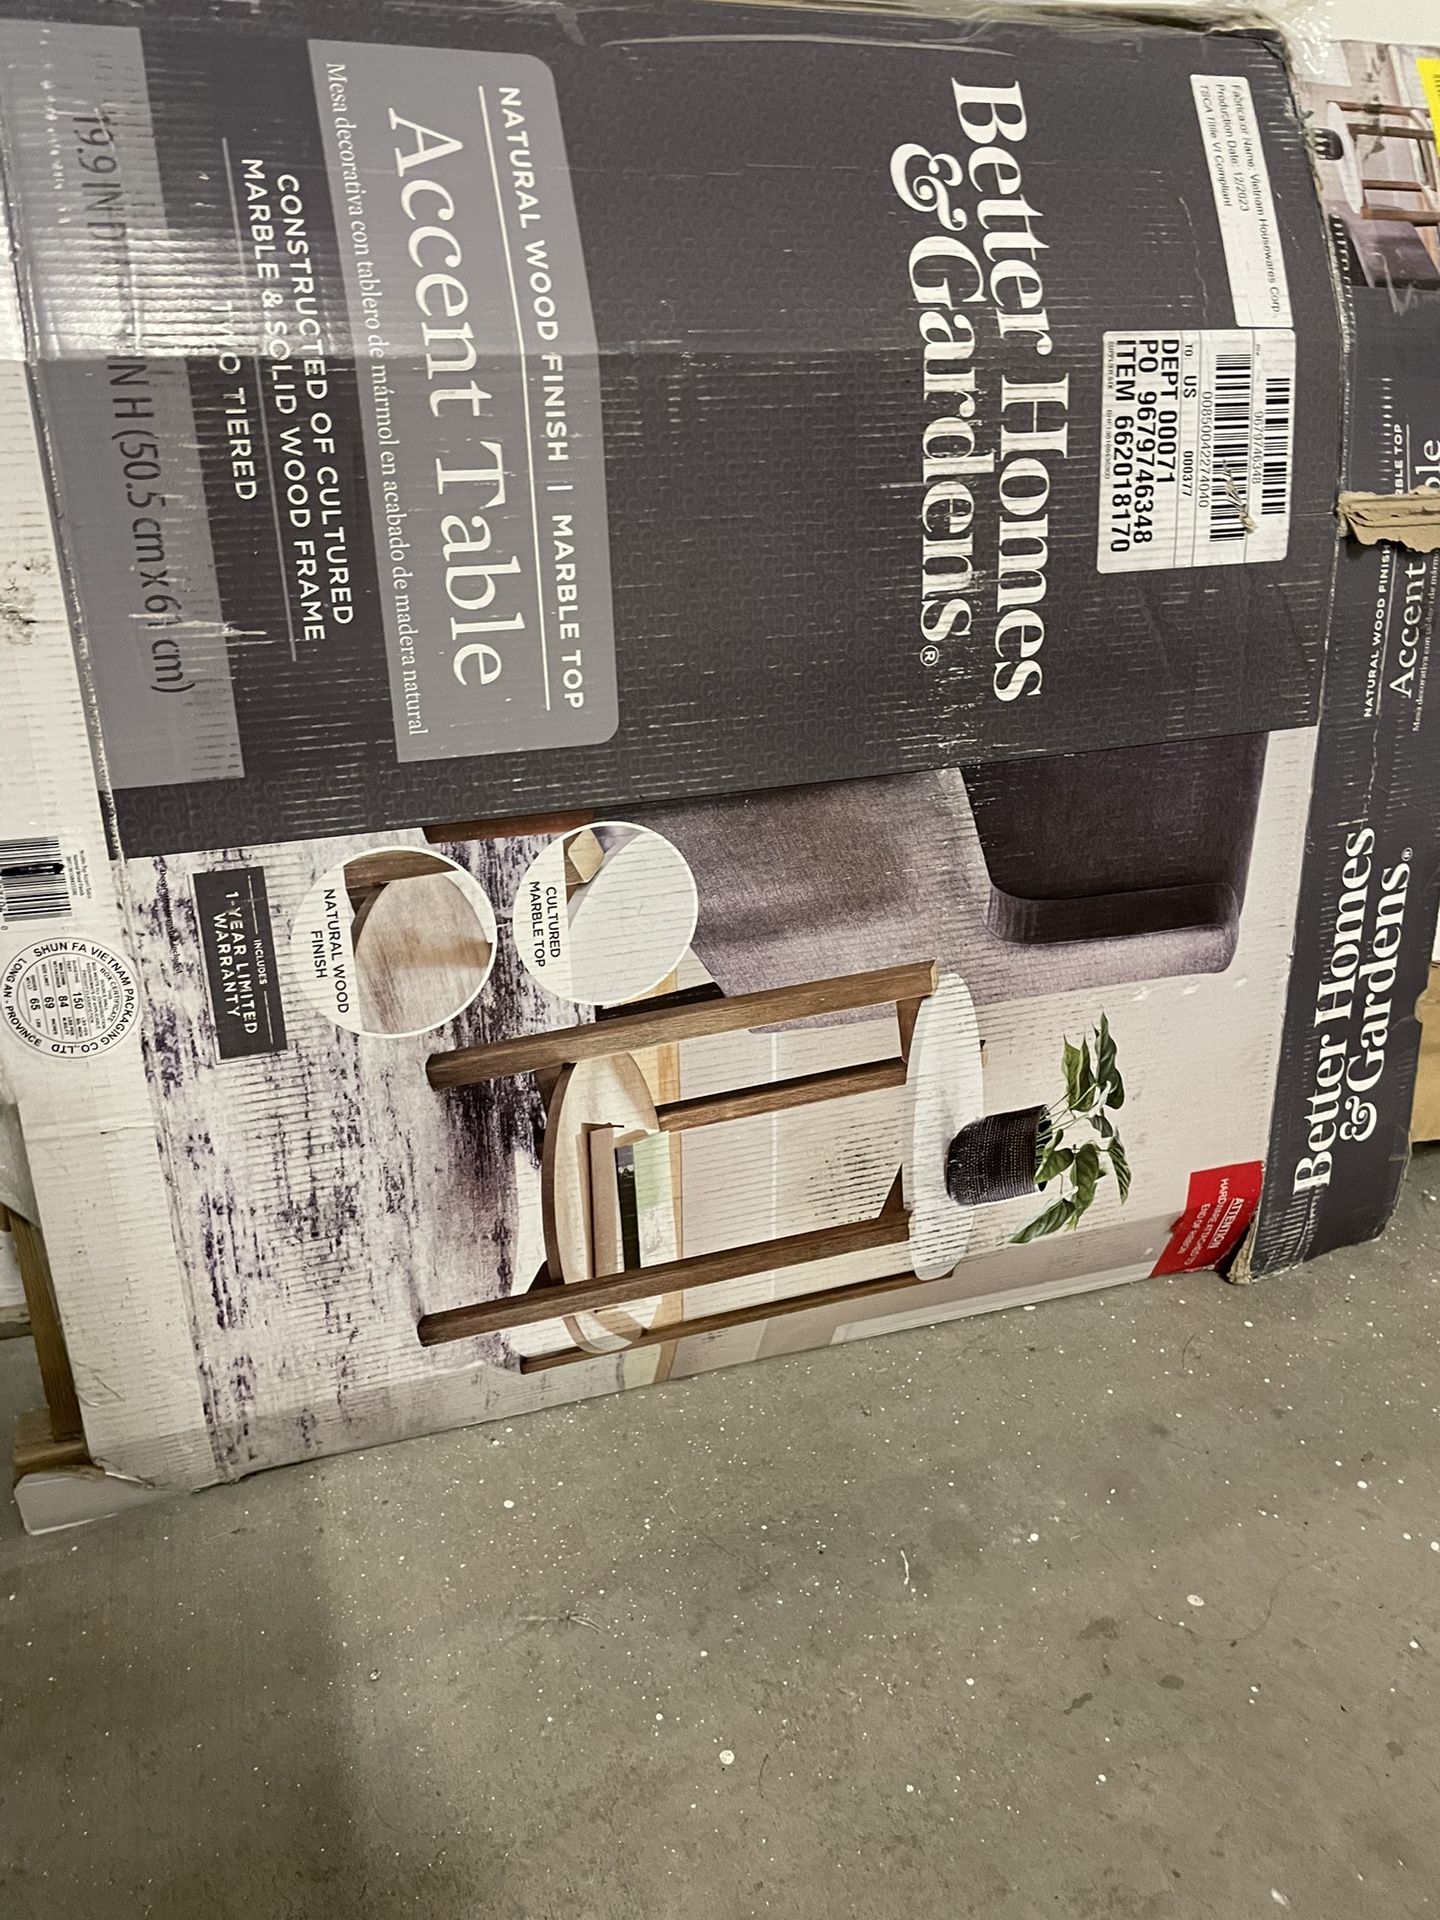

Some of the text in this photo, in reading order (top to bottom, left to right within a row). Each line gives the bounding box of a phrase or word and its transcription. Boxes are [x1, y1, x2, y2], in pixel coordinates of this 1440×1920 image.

[1198, 84, 1213, 113] TSCA
[71, 114, 117, 174] 19.9
[1212, 142, 1223, 152] VI
[1215, 84, 1250, 212] Production Date: 12/2023
[82, 182, 126, 212] IN
[1213, 155, 1233, 207] Compliant
[1232, 84, 1282, 319] Fabricaor Name: Vietnam Housewares Corp.
[106, 356, 150, 386] IN
[388, 107, 526, 686] Accent Table
[951, 77, 1069, 702] Better Homes
[1183, 375, 1196, 398] US
[112, 397, 154, 418] H
[241, 159, 325, 640] MARBLE & SOLID WOOD FRAME
[277, 174, 354, 624] CONSTRUCTED OF CULTURED
[326, 62, 428, 736] Mesa decorativa con tablero de mármol en acabado de madera natural
[498, 86, 584, 709] NATURAL WOOD FINISH MARBLE TOP
[1156, 339, 1179, 484] DEPT 00071
[222, 388, 257, 500] TIERED
[1110, 340, 1136, 552] ITEM 662018170
[1133, 339, 1158, 544] PO 9679746348
[1198, 392, 1213, 508] 00850042274040
[1250, 410, 1264, 484] 9679746348
[111, 429, 166, 508] (50.5
[1181, 450, 1194, 496] 000377
[130, 517, 166, 563] cm
[140, 571, 171, 589] x
[1363, 424, 1404, 718] NATURAL WOOD FINISH RBLE TOP
[145, 594, 184, 629] 61
[1389, 562, 1427, 698] Accent
[150, 639, 196, 694] cm)
[1422, 636, 1432, 654] con
[1416, 656, 1430, 705] decorativa
[1411, 706, 1424, 732] Mesa
[72, 942, 87, 952] FA
[528, 881, 546, 968] MARBLE TOP
[544, 886, 562, 958] CULTURED
[6, 958, 27, 982] LONG
[32, 942, 68, 957] SHUN
[90, 947, 131, 986] VIETNAM
[212, 912, 241, 1018] WARRANTY
[224, 891, 258, 1034] 1-YEAR LIMITED
[253, 938, 268, 984] INCLUDES
[310, 930, 328, 978] FINISH
[322, 888, 350, 1014] NATURAL WOOD
[4, 984, 13, 998] AN
[30, 998, 40, 1010] 65
[44, 996, 54, 1008] 69
[58, 996, 69, 1008] 84
[72, 992, 84, 1010] 150
[107, 982, 120, 1022] CERTIFICATE
[1292, 827, 1376, 1194] Better Homes
[5, 1006, 42, 1046] PROVINCE
[100, 988, 134, 1046] PACKAGING
[1207, 1198, 1244, 1249] ATTENTION
